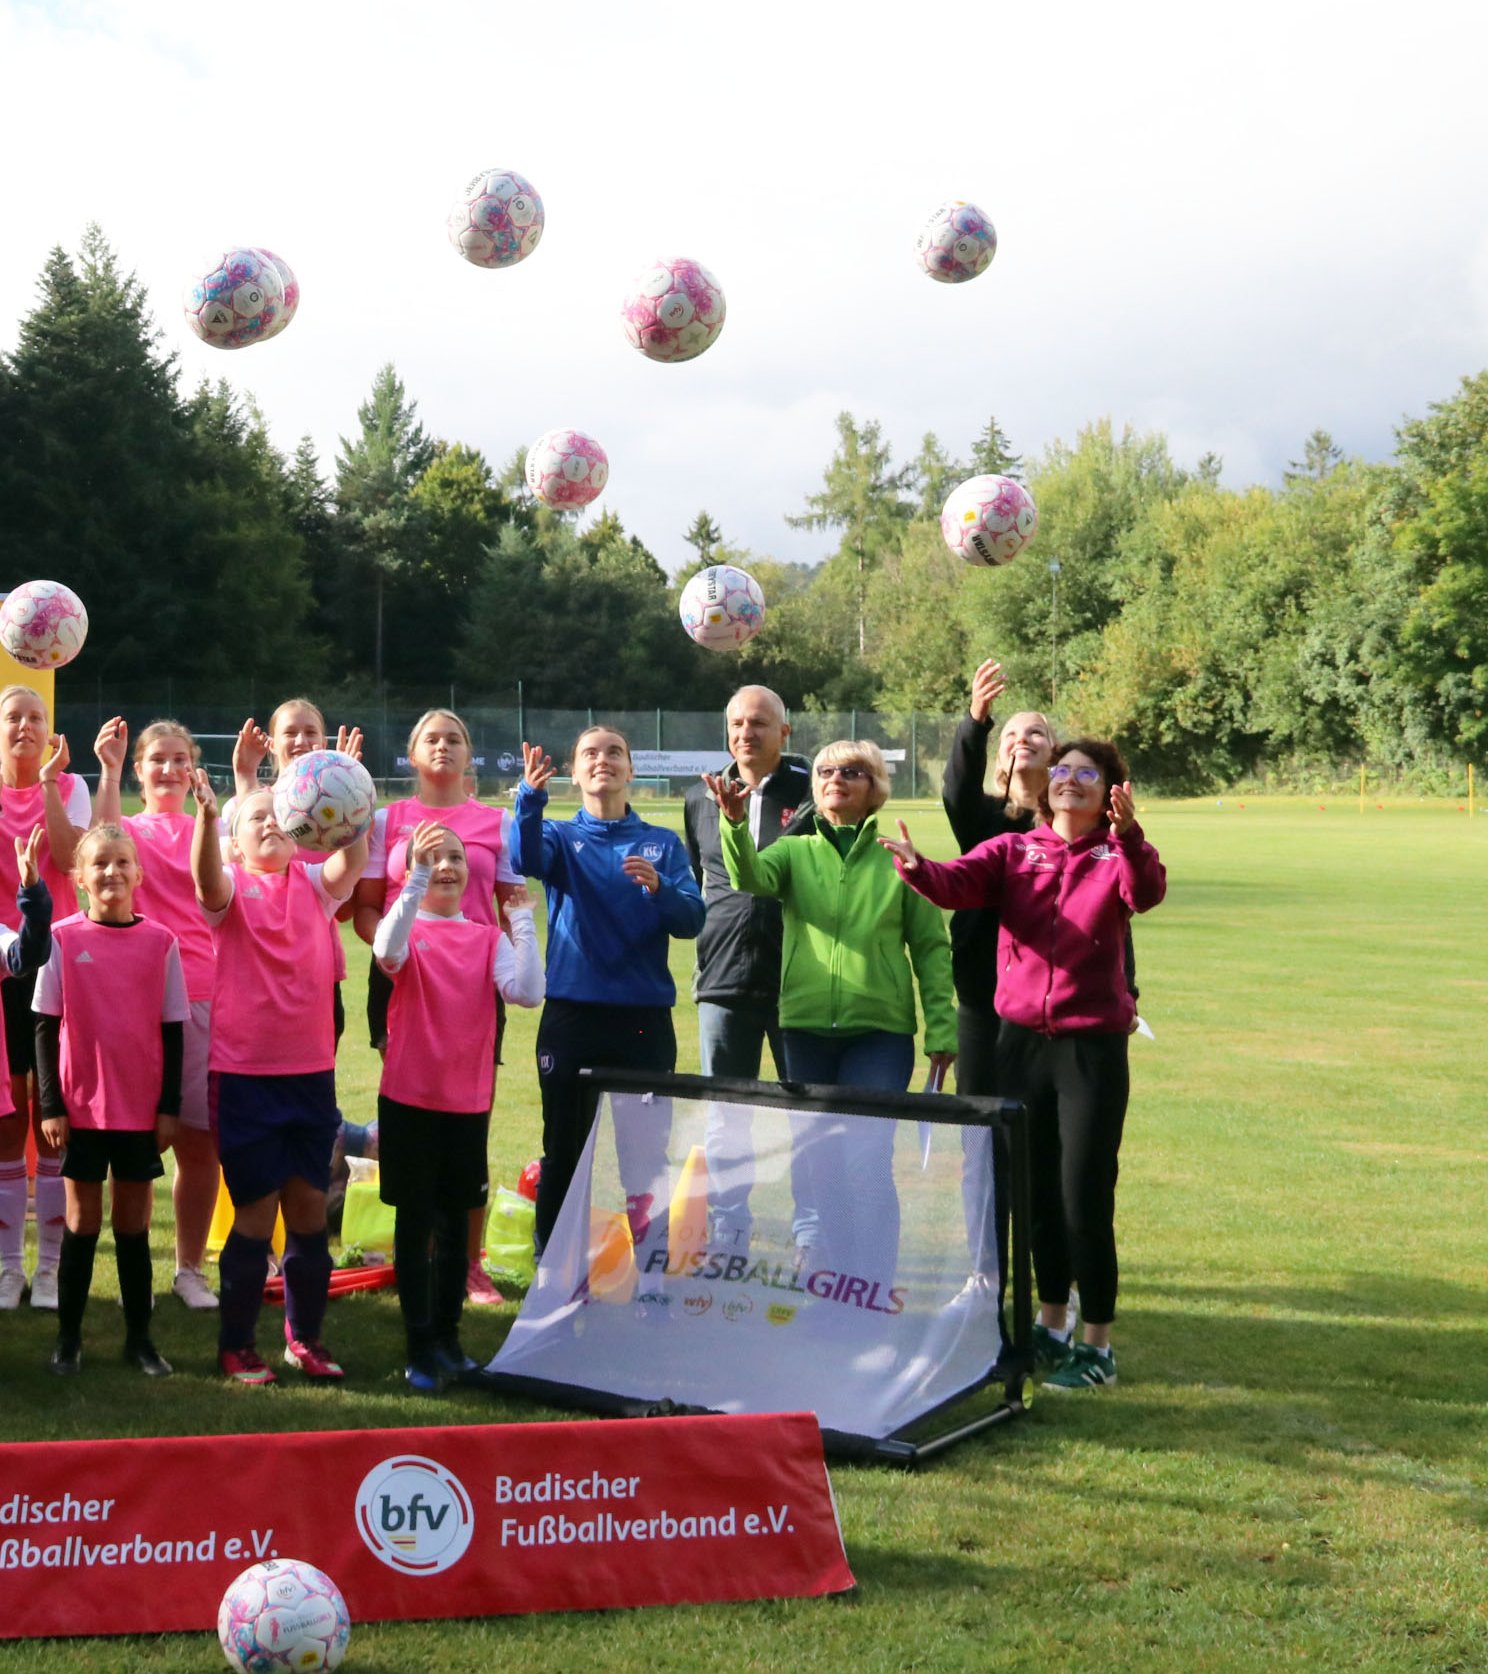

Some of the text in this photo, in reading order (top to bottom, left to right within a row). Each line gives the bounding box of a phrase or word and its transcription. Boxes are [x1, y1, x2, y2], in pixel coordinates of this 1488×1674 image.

[643, 845, 658, 857] KSC
[644, 1249, 909, 1315] FUSSBALLGIRLS
[495, 1470, 641, 1503] Badischer
[380, 1493, 450, 1532] bfv
[500, 1505, 794, 1547] Fußballverband e.V.
[224, 1529, 278, 1560] e.V.
